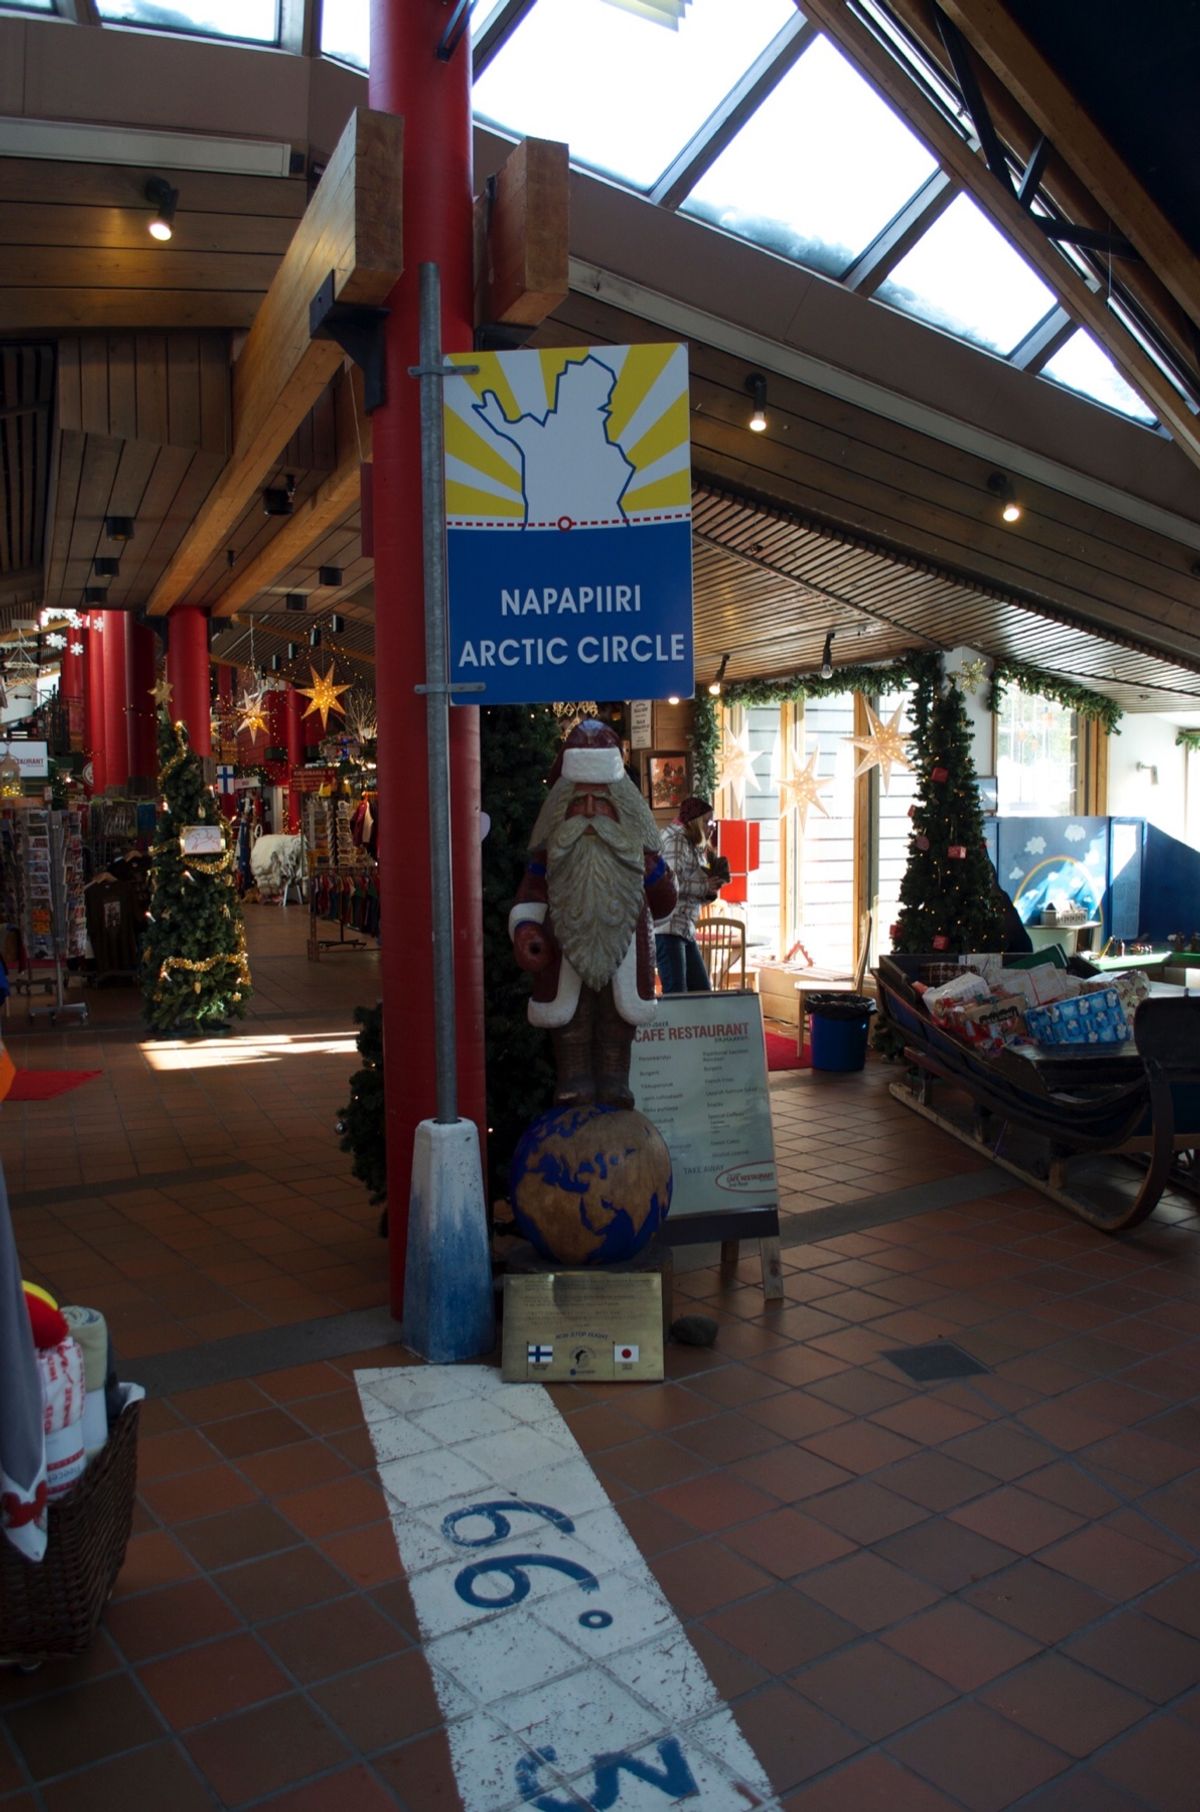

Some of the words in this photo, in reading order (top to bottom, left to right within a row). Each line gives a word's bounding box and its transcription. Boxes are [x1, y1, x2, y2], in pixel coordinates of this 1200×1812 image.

[501, 584, 641, 616] NAPAPIIRI
[458, 637, 568, 668] ARCTIC
[577, 634, 685, 664] CIRCLE
[634, 1028, 665, 1043] CAFE
[669, 1022, 749, 1040] RESTAURANT
[441, 1500, 613, 1629] 66°
